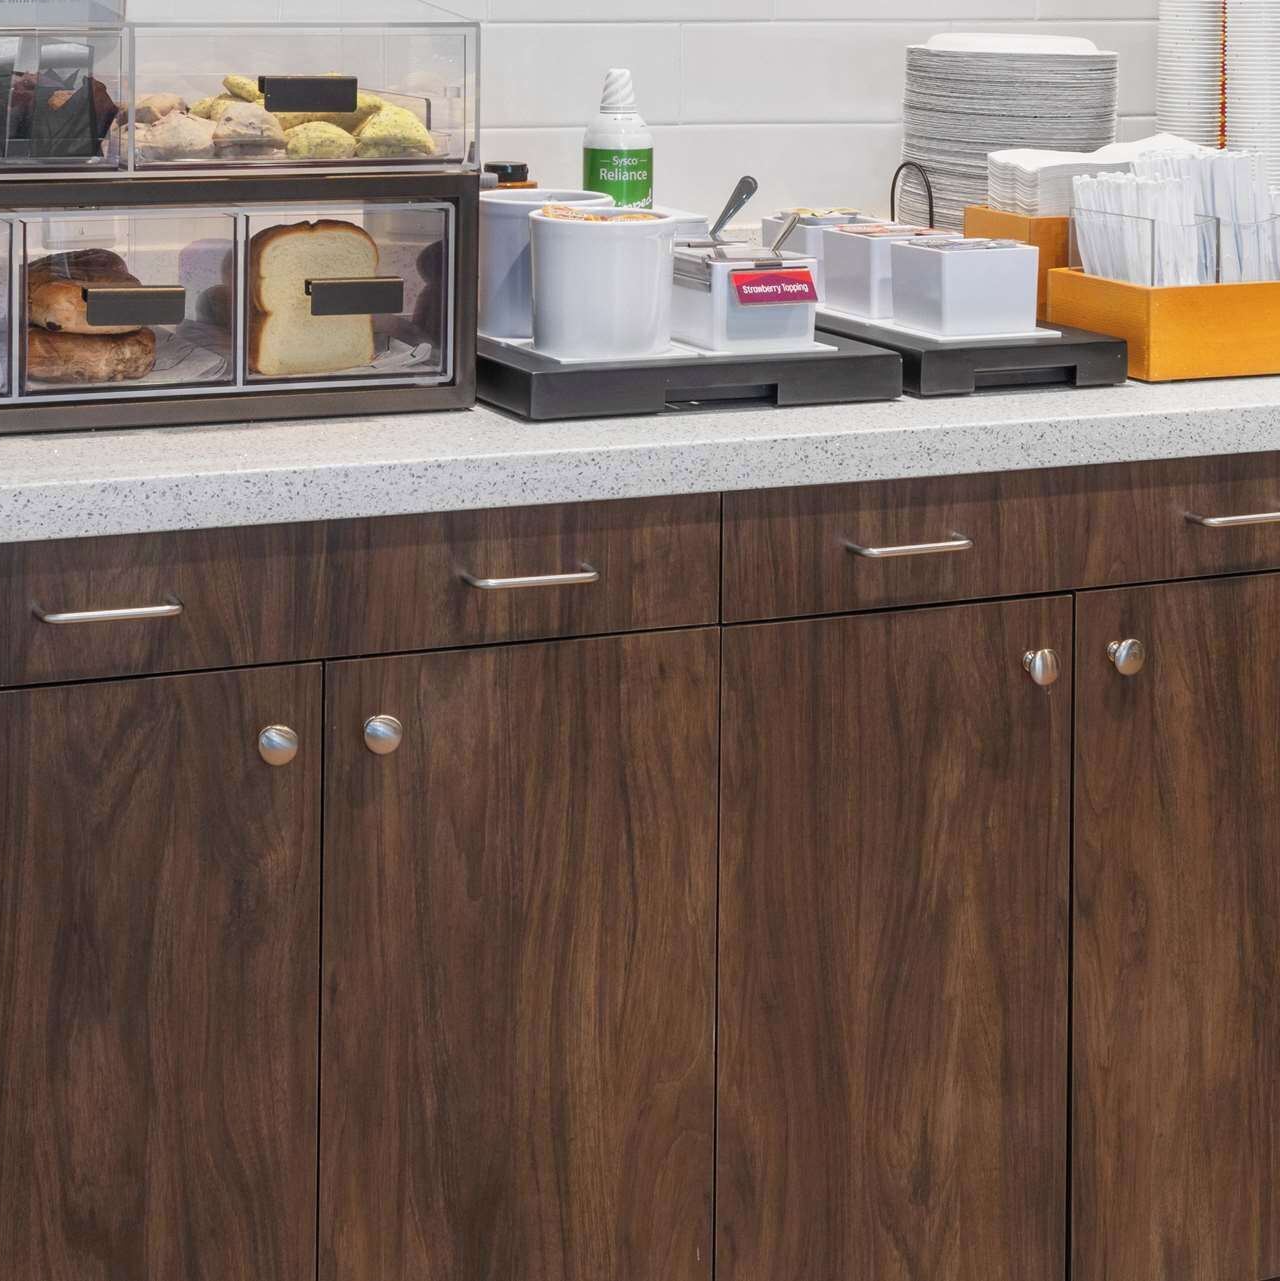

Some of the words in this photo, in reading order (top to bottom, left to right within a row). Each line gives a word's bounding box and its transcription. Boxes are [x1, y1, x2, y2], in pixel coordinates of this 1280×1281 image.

[612, 156, 638, 167] Sysco
[600, 168, 648, 181] Reliance
[742, 283, 781, 294] Strawberry
[782, 283, 809, 293] Topping
